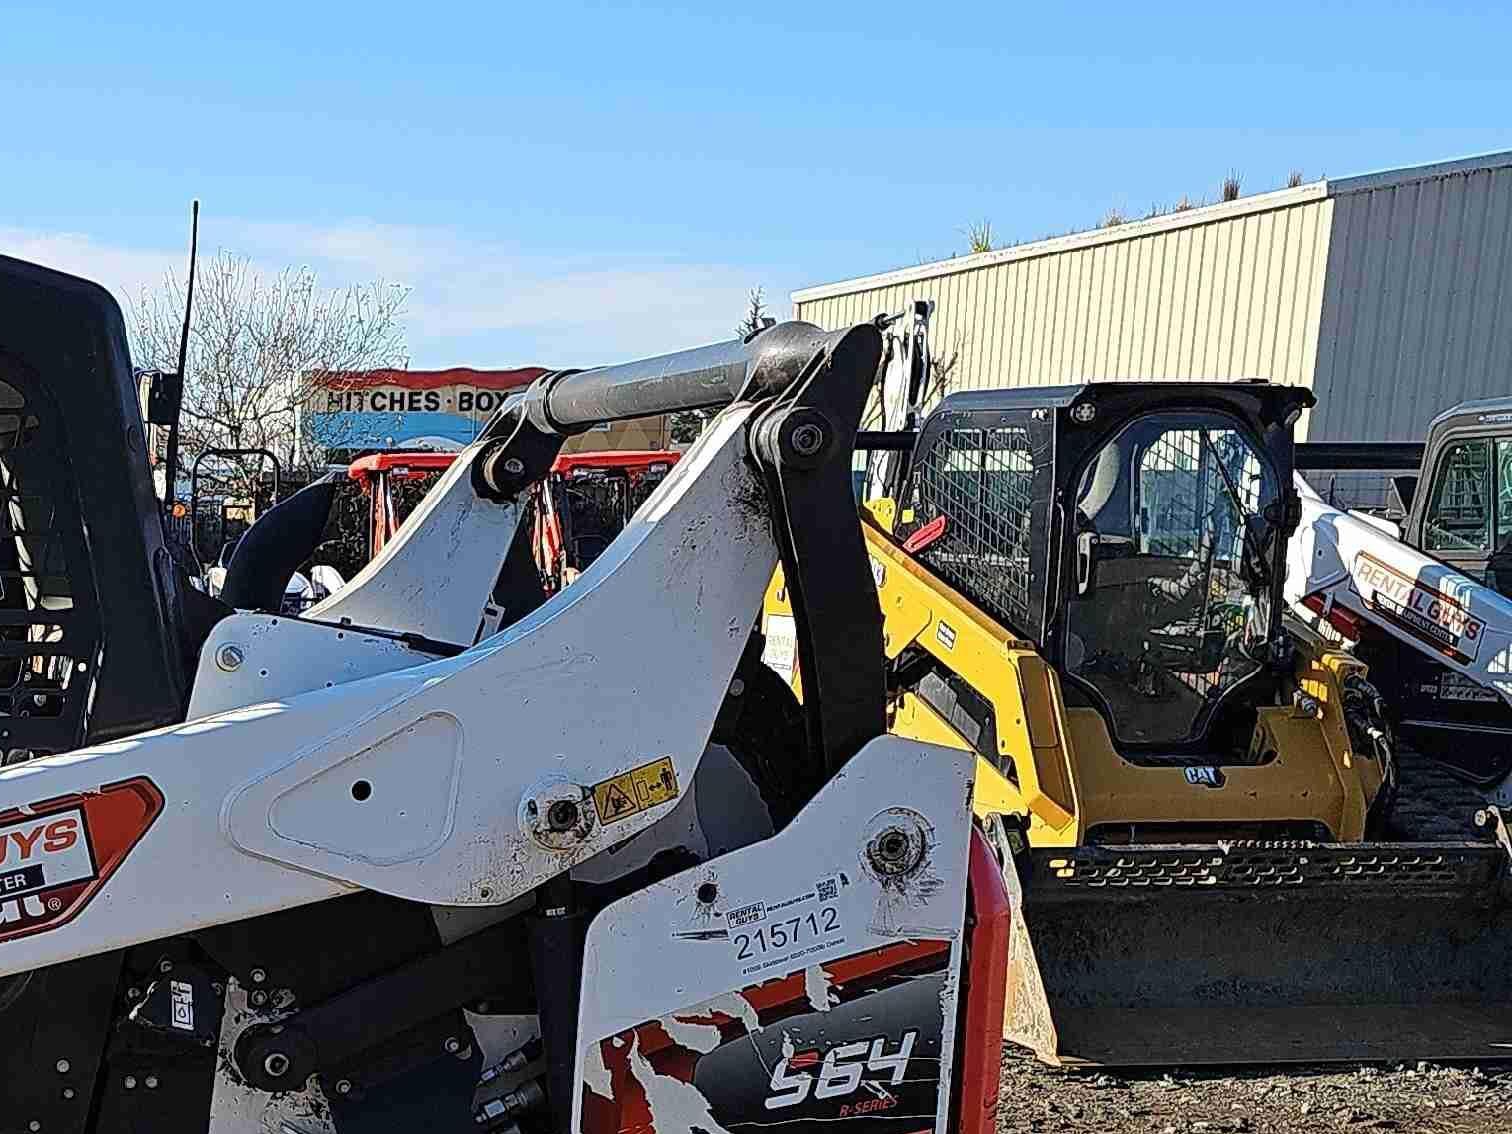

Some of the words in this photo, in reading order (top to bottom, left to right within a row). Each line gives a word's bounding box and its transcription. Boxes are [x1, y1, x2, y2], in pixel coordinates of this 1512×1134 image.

[327, 391, 441, 412] HITCHES
[1185, 767, 1217, 784] CAT
[734, 907, 841, 960] 215712
[764, 1031, 917, 1110] S64
